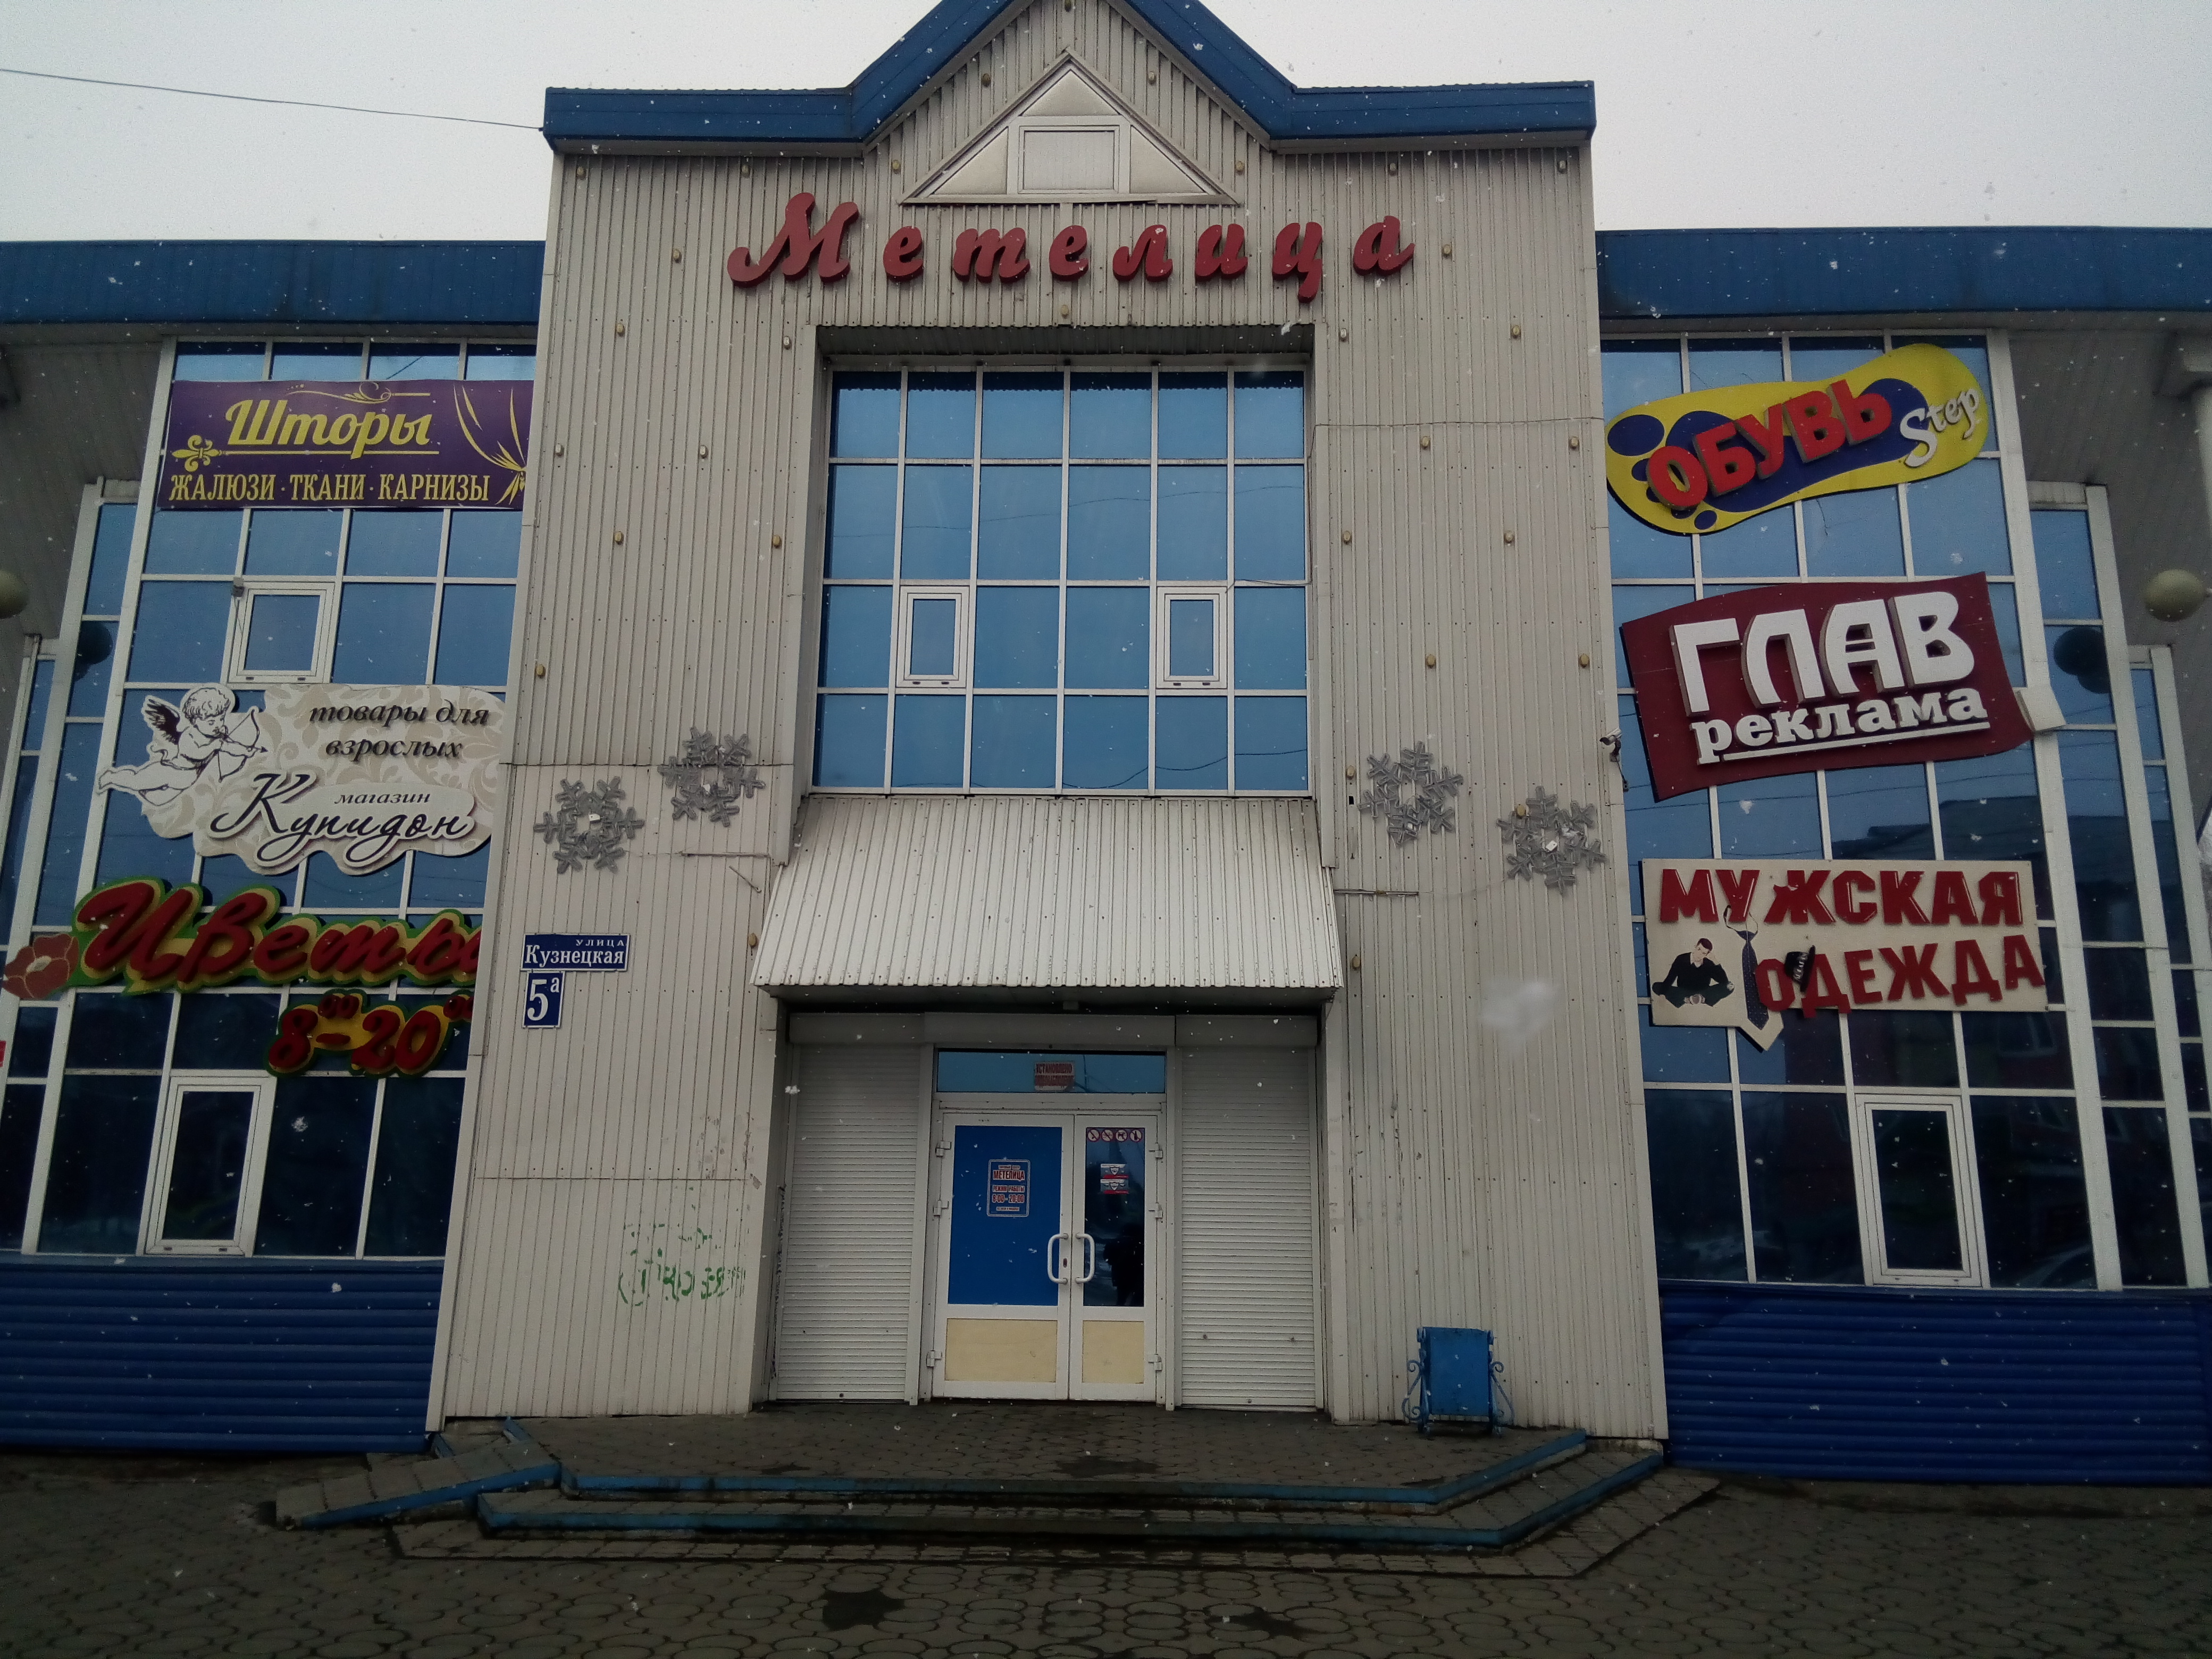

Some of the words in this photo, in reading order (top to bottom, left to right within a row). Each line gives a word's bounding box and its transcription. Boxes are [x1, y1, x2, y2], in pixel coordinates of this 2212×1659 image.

[726, 192, 1415, 303] Метелица
[225, 399, 432, 459] Шторы
[1646, 379, 1891, 510] ОБУВЬ
[1899, 387, 1980, 467] Step
[169, 474, 276, 501] ЖАЛЮЗИ
[290, 474, 365, 501] ТКАНИ
[378, 474, 490, 501] КАРНИЗЫ
[1669, 591, 1975, 717] ГЛАВ
[309, 702, 427, 728] товары
[435, 699, 490, 726] для
[1689, 688, 1988, 765] реклама
[326, 738, 463, 761] взрослых
[211, 773, 470, 862] Купидон
[334, 791, 431, 805] магазин
[1660, 868, 2023, 925] МУЖСКАЯ
[525, 944, 624, 968] Кузнецкая
[1756, 935, 2045, 1018] ОДЕЖДА
[993, 1170, 1025, 1180] МЕТЕЛИЦА
